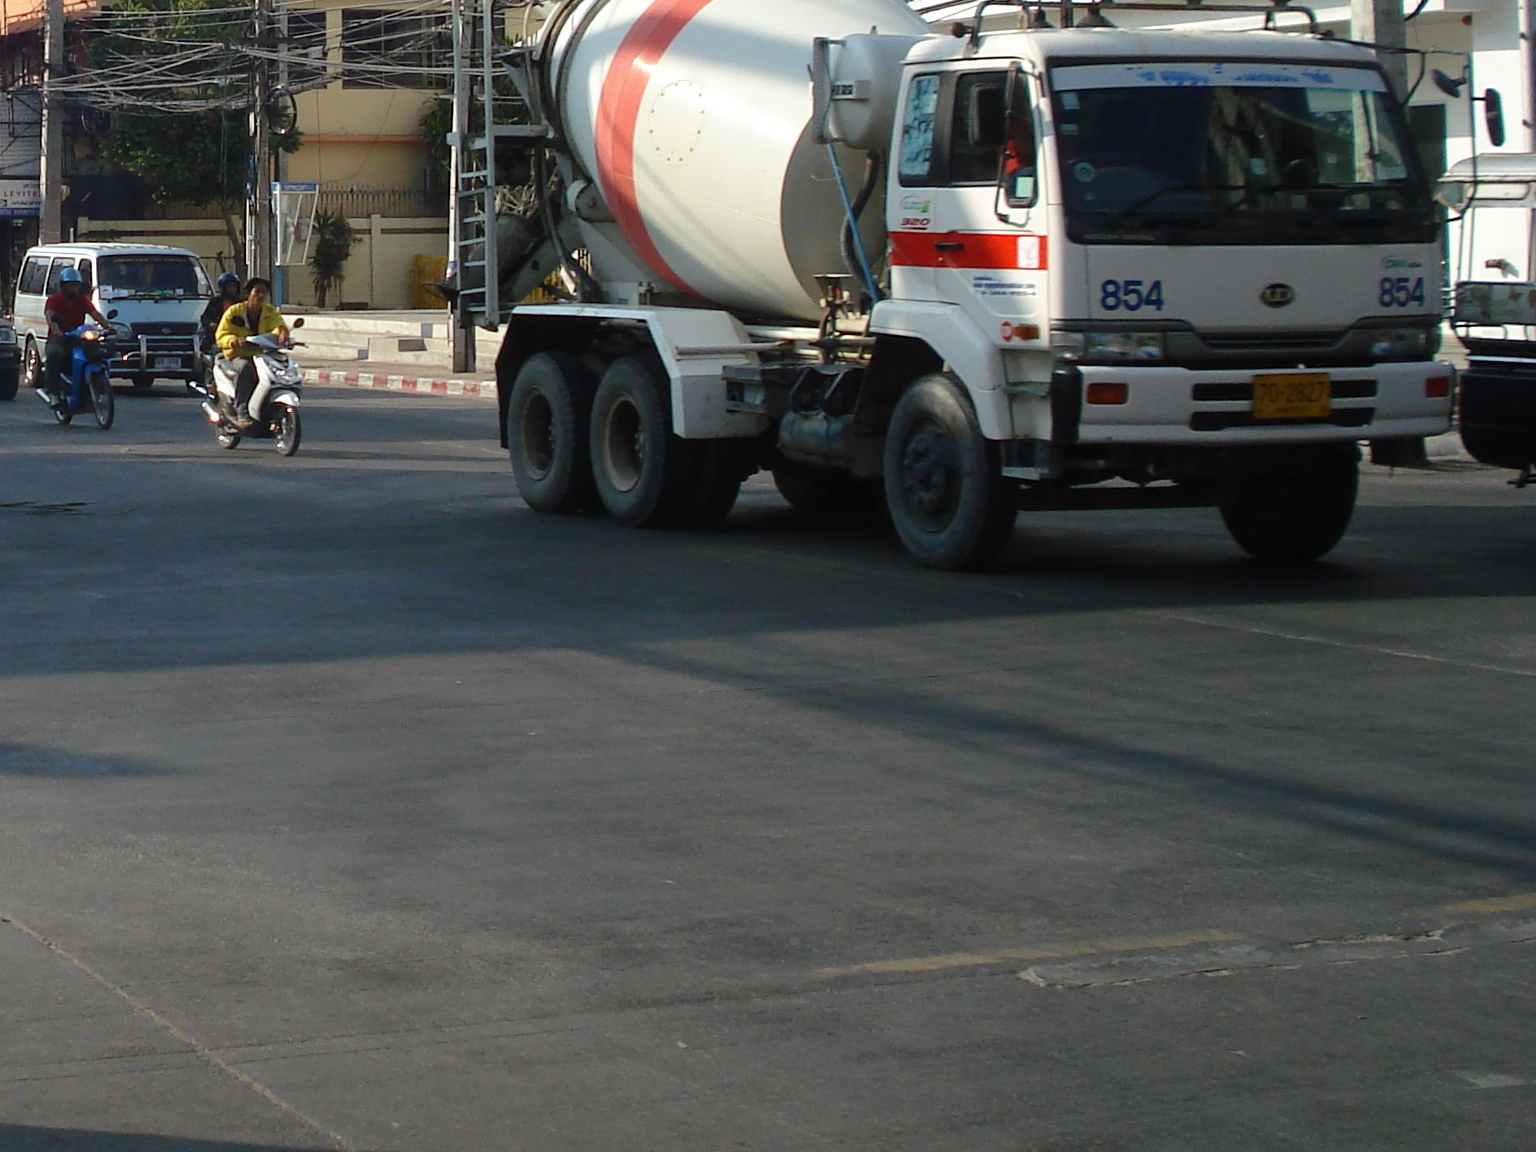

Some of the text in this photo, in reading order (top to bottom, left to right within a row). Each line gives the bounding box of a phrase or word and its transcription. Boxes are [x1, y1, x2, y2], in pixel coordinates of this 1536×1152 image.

[900, 218, 931, 226] 320
[1100, 279, 1164, 311] 854
[1379, 277, 1425, 307] 854
